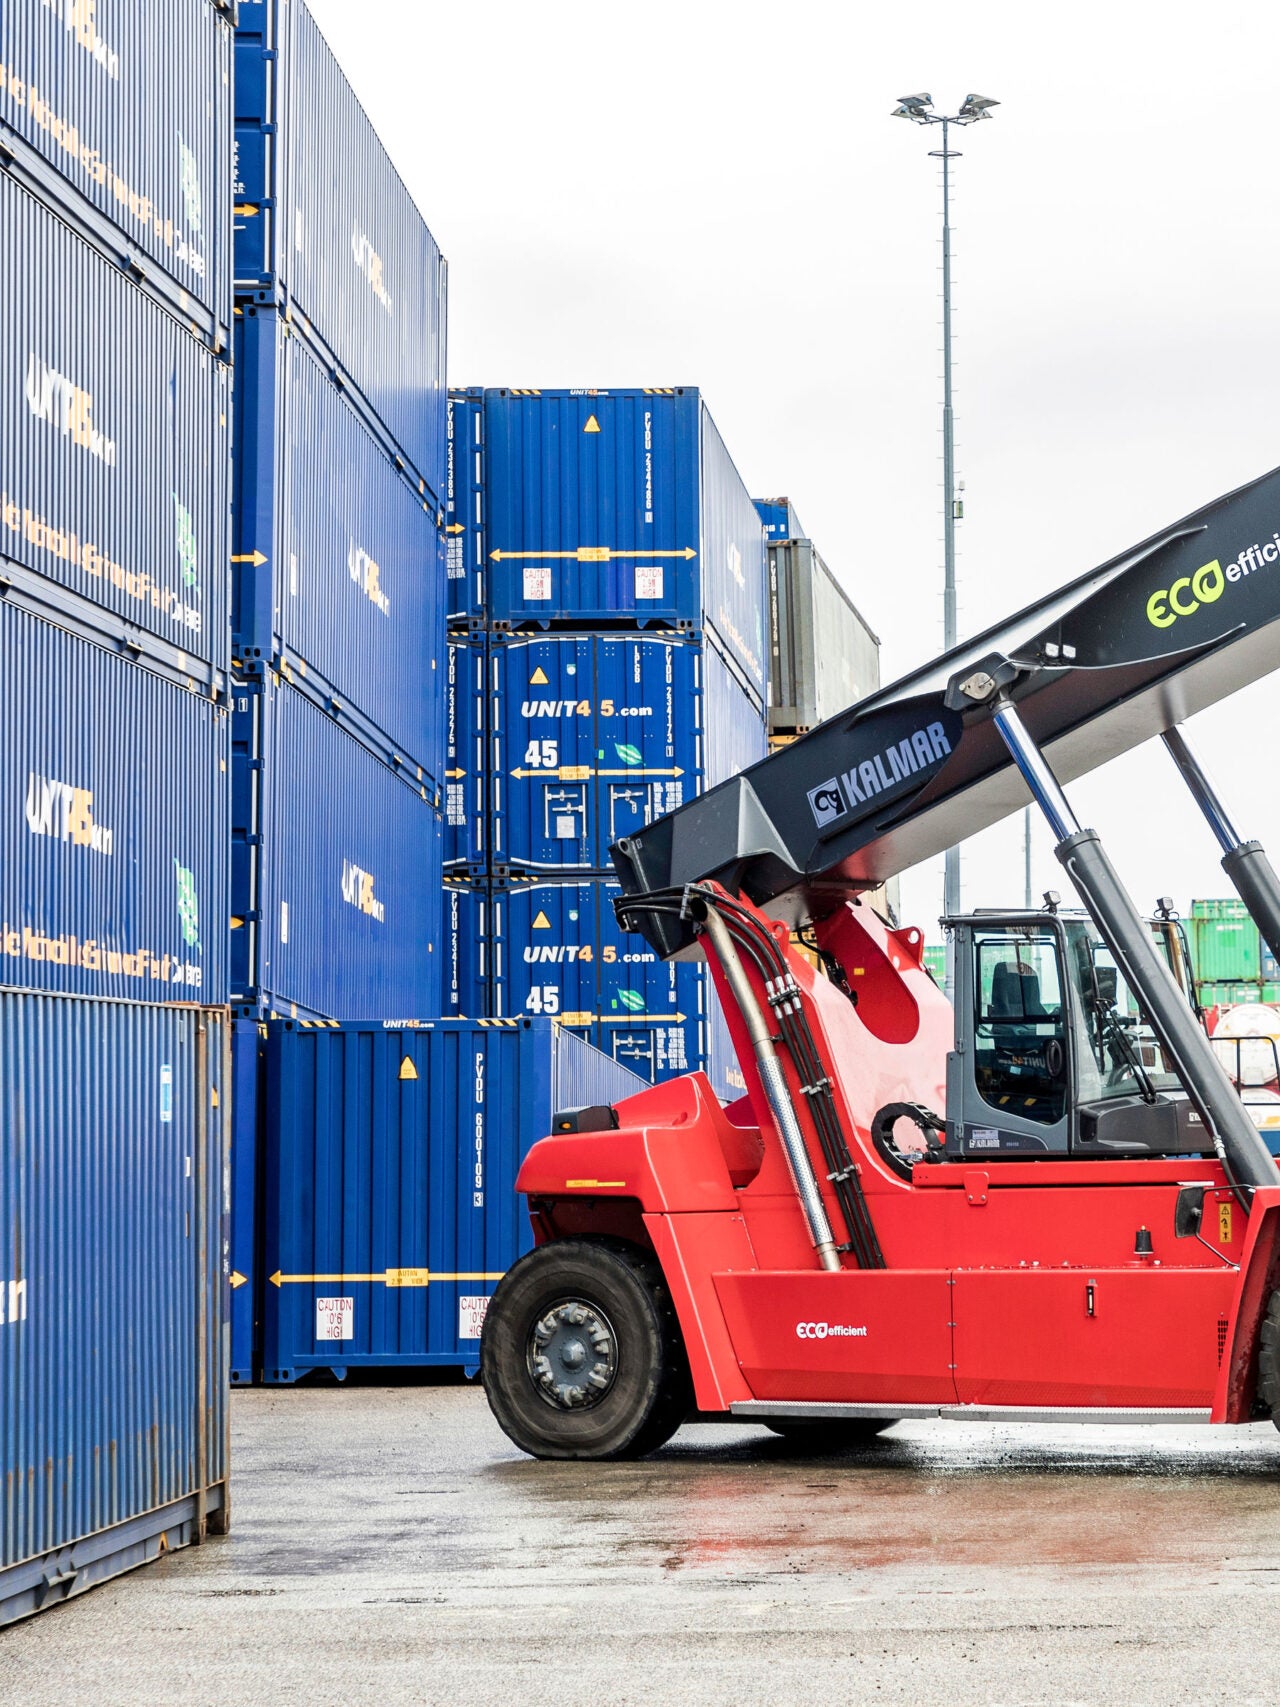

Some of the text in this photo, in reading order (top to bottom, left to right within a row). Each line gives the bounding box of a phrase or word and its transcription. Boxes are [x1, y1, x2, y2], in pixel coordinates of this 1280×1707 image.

[644, 411, 652, 449] PVDU
[524, 740, 559, 768] 45
[841, 720, 953, 808] KALMAR
[525, 985, 560, 1014] 45
[473, 1052, 484, 1208] PVDU 600109 3
[828, 1324, 867, 1338] efficient
